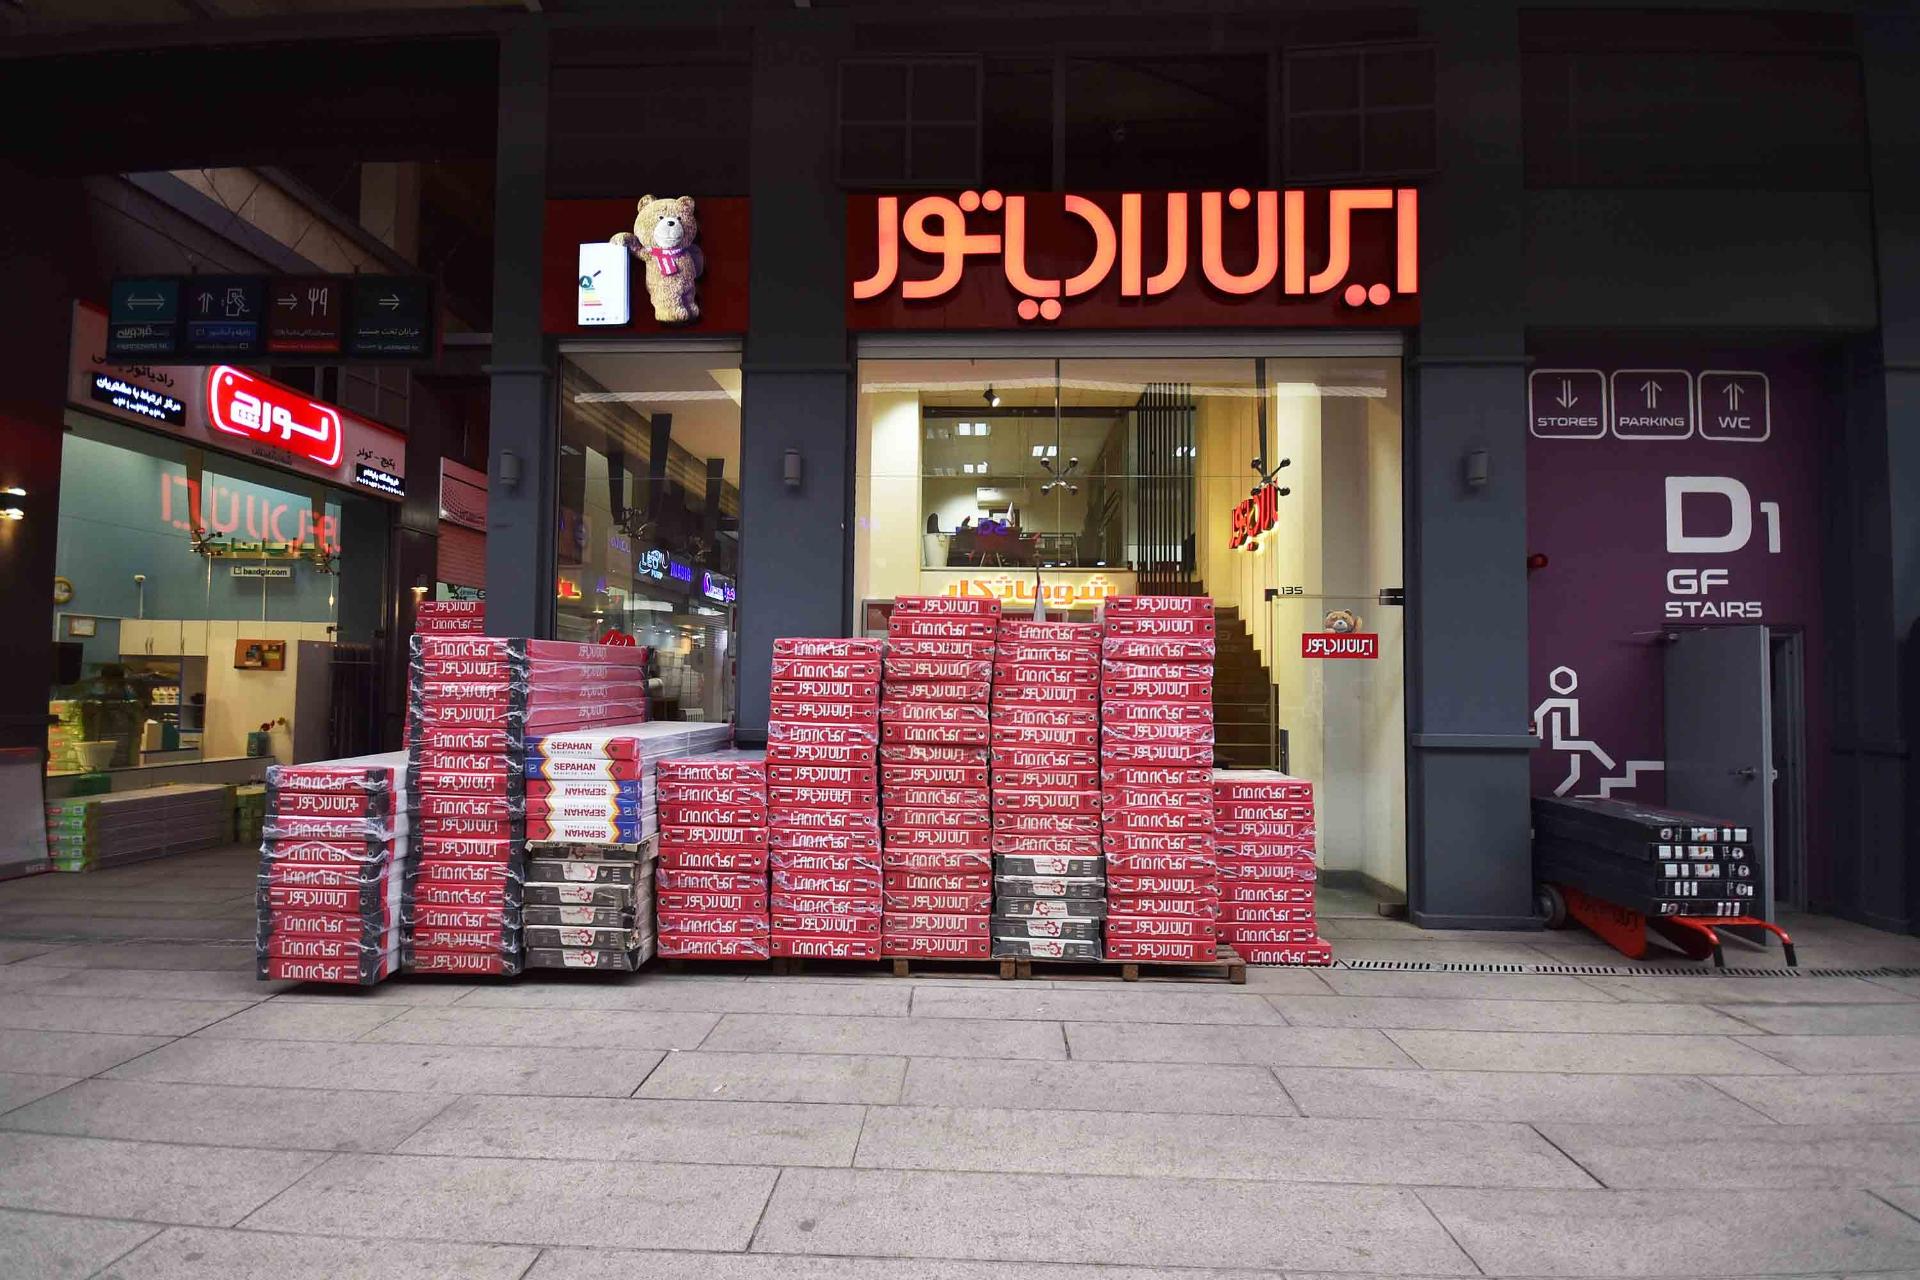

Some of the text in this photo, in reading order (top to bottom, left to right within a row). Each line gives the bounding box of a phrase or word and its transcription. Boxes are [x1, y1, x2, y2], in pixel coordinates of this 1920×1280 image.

[853, 188, 1418, 320] ایران رادیاتور
[96, 376, 181, 411] مرکز ارتباط با مشتریان
[1537, 416, 1598, 427] STORES
[1619, 416, 1685, 427] PARKING
[1718, 416, 1751, 429] WC
[1666, 568, 1729, 594] GF
[1281, 586, 1303, 595] 135
[1665, 601, 1763, 618] STAIRS
[1305, 639, 1373, 655] ایران رادیاتور
[551, 742, 592, 750] SEPAHAN
[553, 763, 596, 771] SEPAHAN
[565, 788, 607, 796] SEPAHAN
[564, 809, 606, 817] SEPAHAN
[565, 830, 606, 838] SEPAHAN
